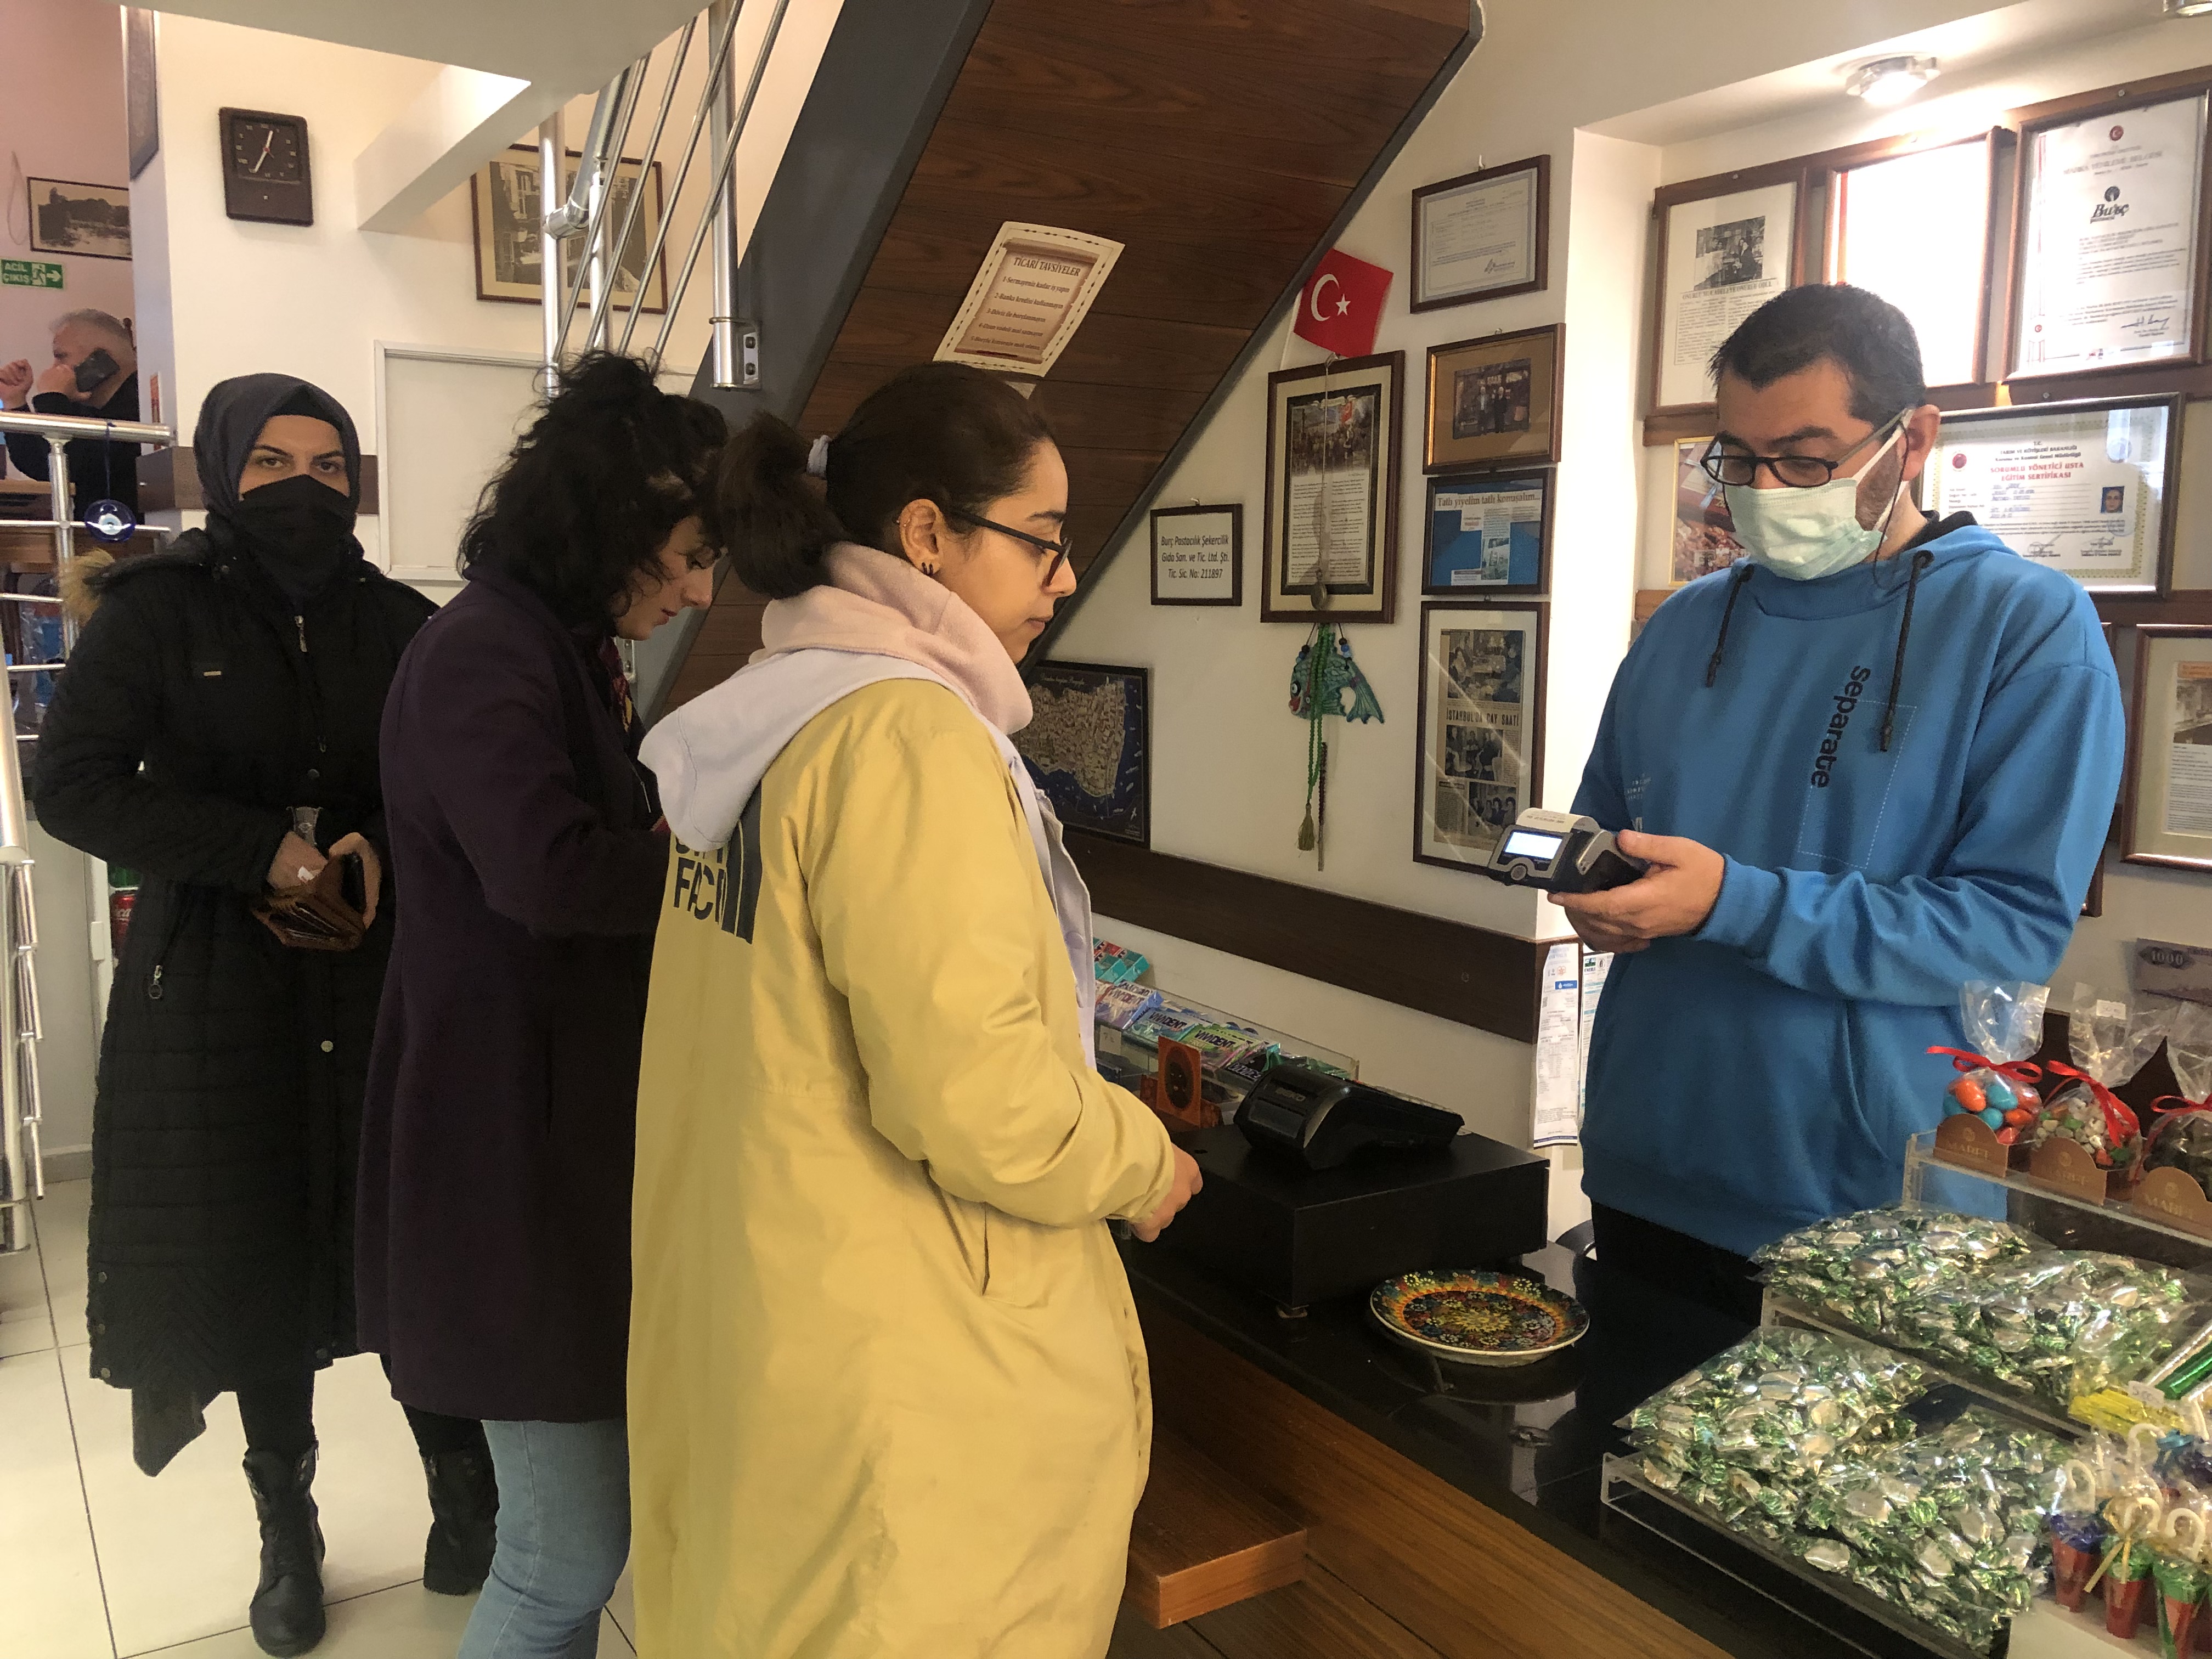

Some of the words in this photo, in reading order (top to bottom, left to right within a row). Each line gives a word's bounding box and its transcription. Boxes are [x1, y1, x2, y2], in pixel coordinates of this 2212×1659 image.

[1013, 256, 1040, 269] TİCARİ
[1039, 261, 1081, 276] TAVSİYELER
[1036, 281, 1052, 290] kadar
[2028, 461, 2063, 471] YÖNETİCİ
[2001, 473, 2025, 481] EĞİTİM
[2028, 471, 2071, 480] SERTİFİKASI
[1454, 496, 1480, 508] yiyelim
[1482, 495, 1496, 504] tatlı
[1161, 535, 1174, 548] Burç
[1175, 534, 1201, 546] Pastacılık
[1201, 534, 1229, 548] Şekercilik
[1161, 551, 1175, 562] Gıda
[1176, 552, 1187, 562] San.
[1189, 554, 1196, 562] ve
[1197, 551, 1206, 562] Tic.
[1208, 551, 1218, 562] Ltd.
[1220, 551, 1230, 564] Şti.
[1168, 568, 1177, 579] Tic.
[1178, 568, 1188, 579] Sic.
[1189, 568, 1200, 578] No:
[1200, 568, 1223, 579] 211897
[1810, 665, 1871, 788] separate
[2152, 950, 2183, 966] 1000
[1148, 1011, 1188, 1029] VIVIDENT
[1194, 1029, 1237, 1048] VIVIDENT
[1228, 1062, 1262, 1082] VIVIDE
